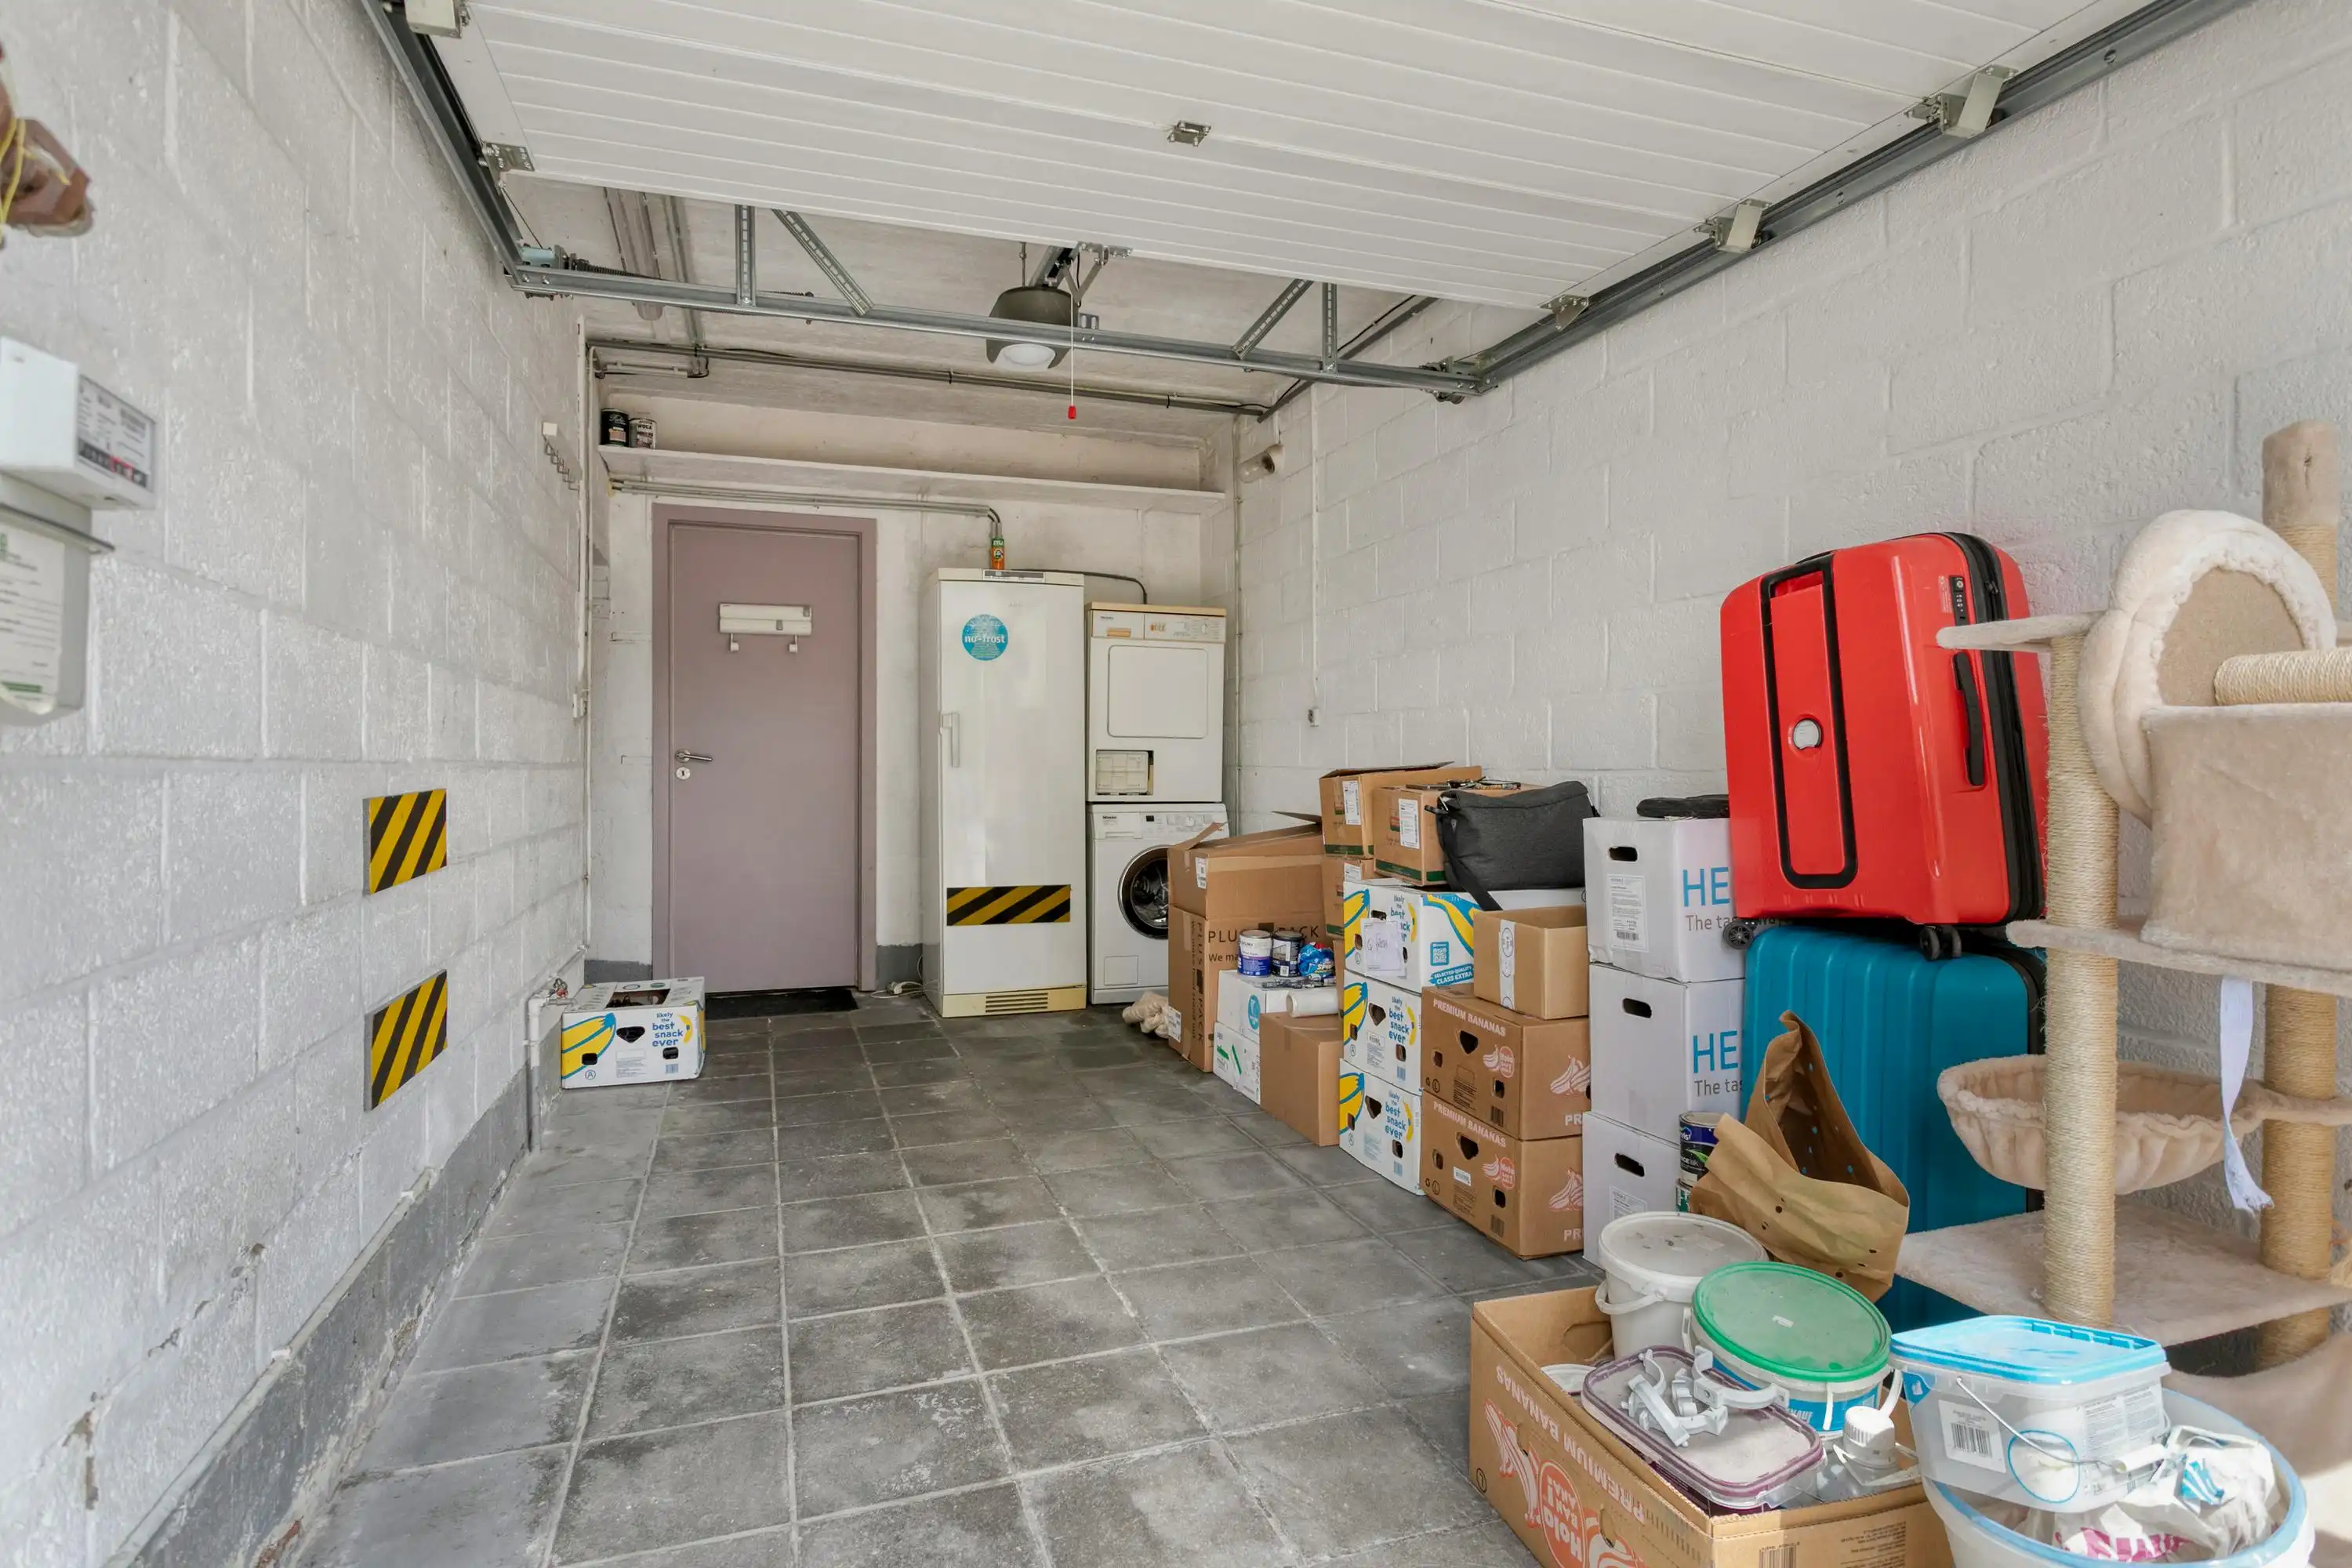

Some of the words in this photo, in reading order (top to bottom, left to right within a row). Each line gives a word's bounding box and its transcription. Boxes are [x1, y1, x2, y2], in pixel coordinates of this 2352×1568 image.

[964, 633, 1005, 643] no-frost
[1686, 915, 1712, 931] The
[1208, 931, 1240, 942] PLU
[1209, 953, 1223, 963] We
[1436, 975, 1454, 985] CLASS
[1455, 971, 1473, 980] EXTRA
[1388, 1007, 1403, 1021] best
[1433, 997, 1466, 1020] PREMIUM
[1468, 1013, 1506, 1036] BANANAS
[652, 1022, 675, 1030] best
[1390, 1021, 1410, 1035] snack
[655, 1029, 684, 1039] snack
[1388, 1030, 1406, 1044] ever
[1694, 1080, 1720, 1097] The
[1385, 1102, 1400, 1117] best
[1387, 1116, 1406, 1131] snack
[1433, 1101, 1466, 1127] PREMIUM
[1468, 1120, 1506, 1147] BANANAS
[1385, 1124, 1403, 1139] ever
[1564, 1229, 1583, 1242] PR
[1495, 1364, 1559, 1443] BANANAS
[1563, 1433, 1646, 1524] PREMIUM
